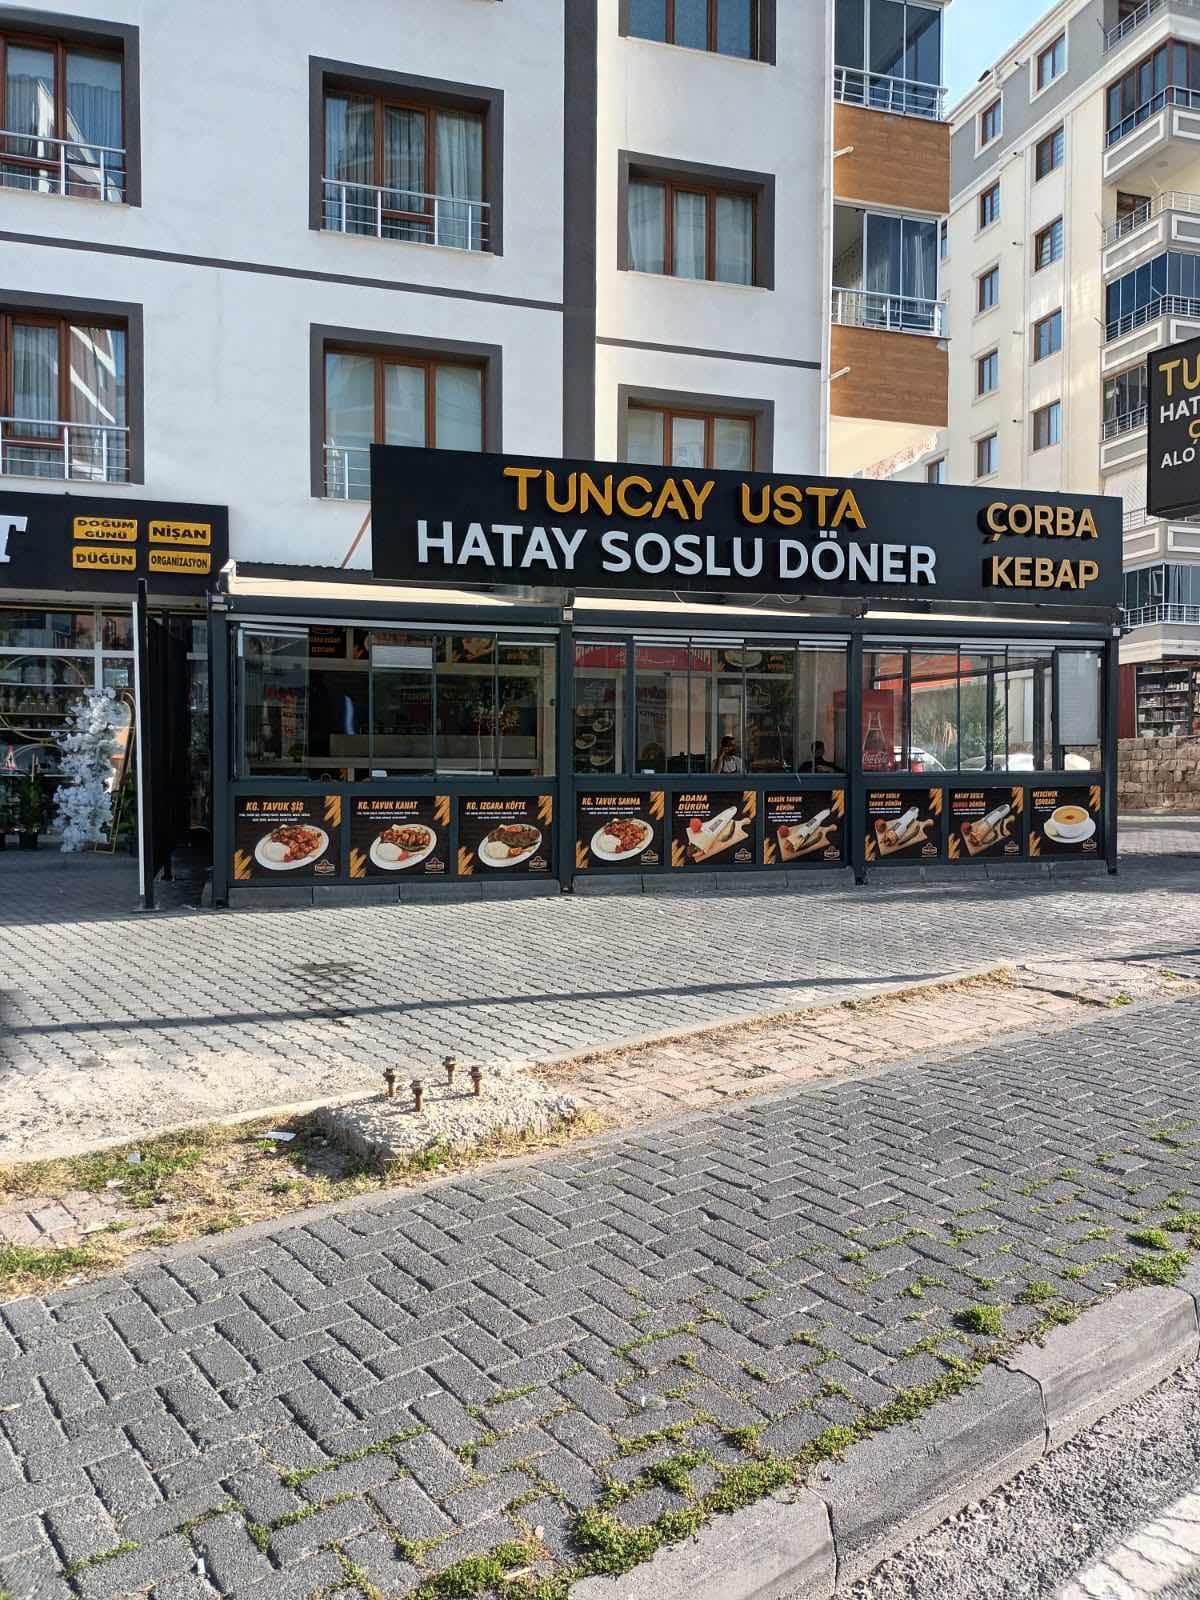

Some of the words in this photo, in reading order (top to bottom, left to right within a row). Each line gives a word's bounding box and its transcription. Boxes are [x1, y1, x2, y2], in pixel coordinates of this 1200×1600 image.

[1160, 447, 1196, 469] ALO
[503, 466, 716, 521] TUNCAY
[741, 482, 867, 529] USTA
[986, 502, 1098, 542] ÇORBA
[152, 525, 207, 541] NİŞAN
[76, 552, 133, 566] DÜĞÜN
[417, 519, 588, 571] HATAY
[601, 530, 763, 578] SOSLU
[779, 529, 937, 585] DÖNER
[151, 555, 208, 569] ORGANİZASYON
[992, 555, 1100, 590] KEBAP
[371, 801, 394, 810] TAVUK
[680, 794, 708, 802] ADANA
[263, 801, 289, 811] TAVUK
[678, 802, 710, 811] DÜRÜM
